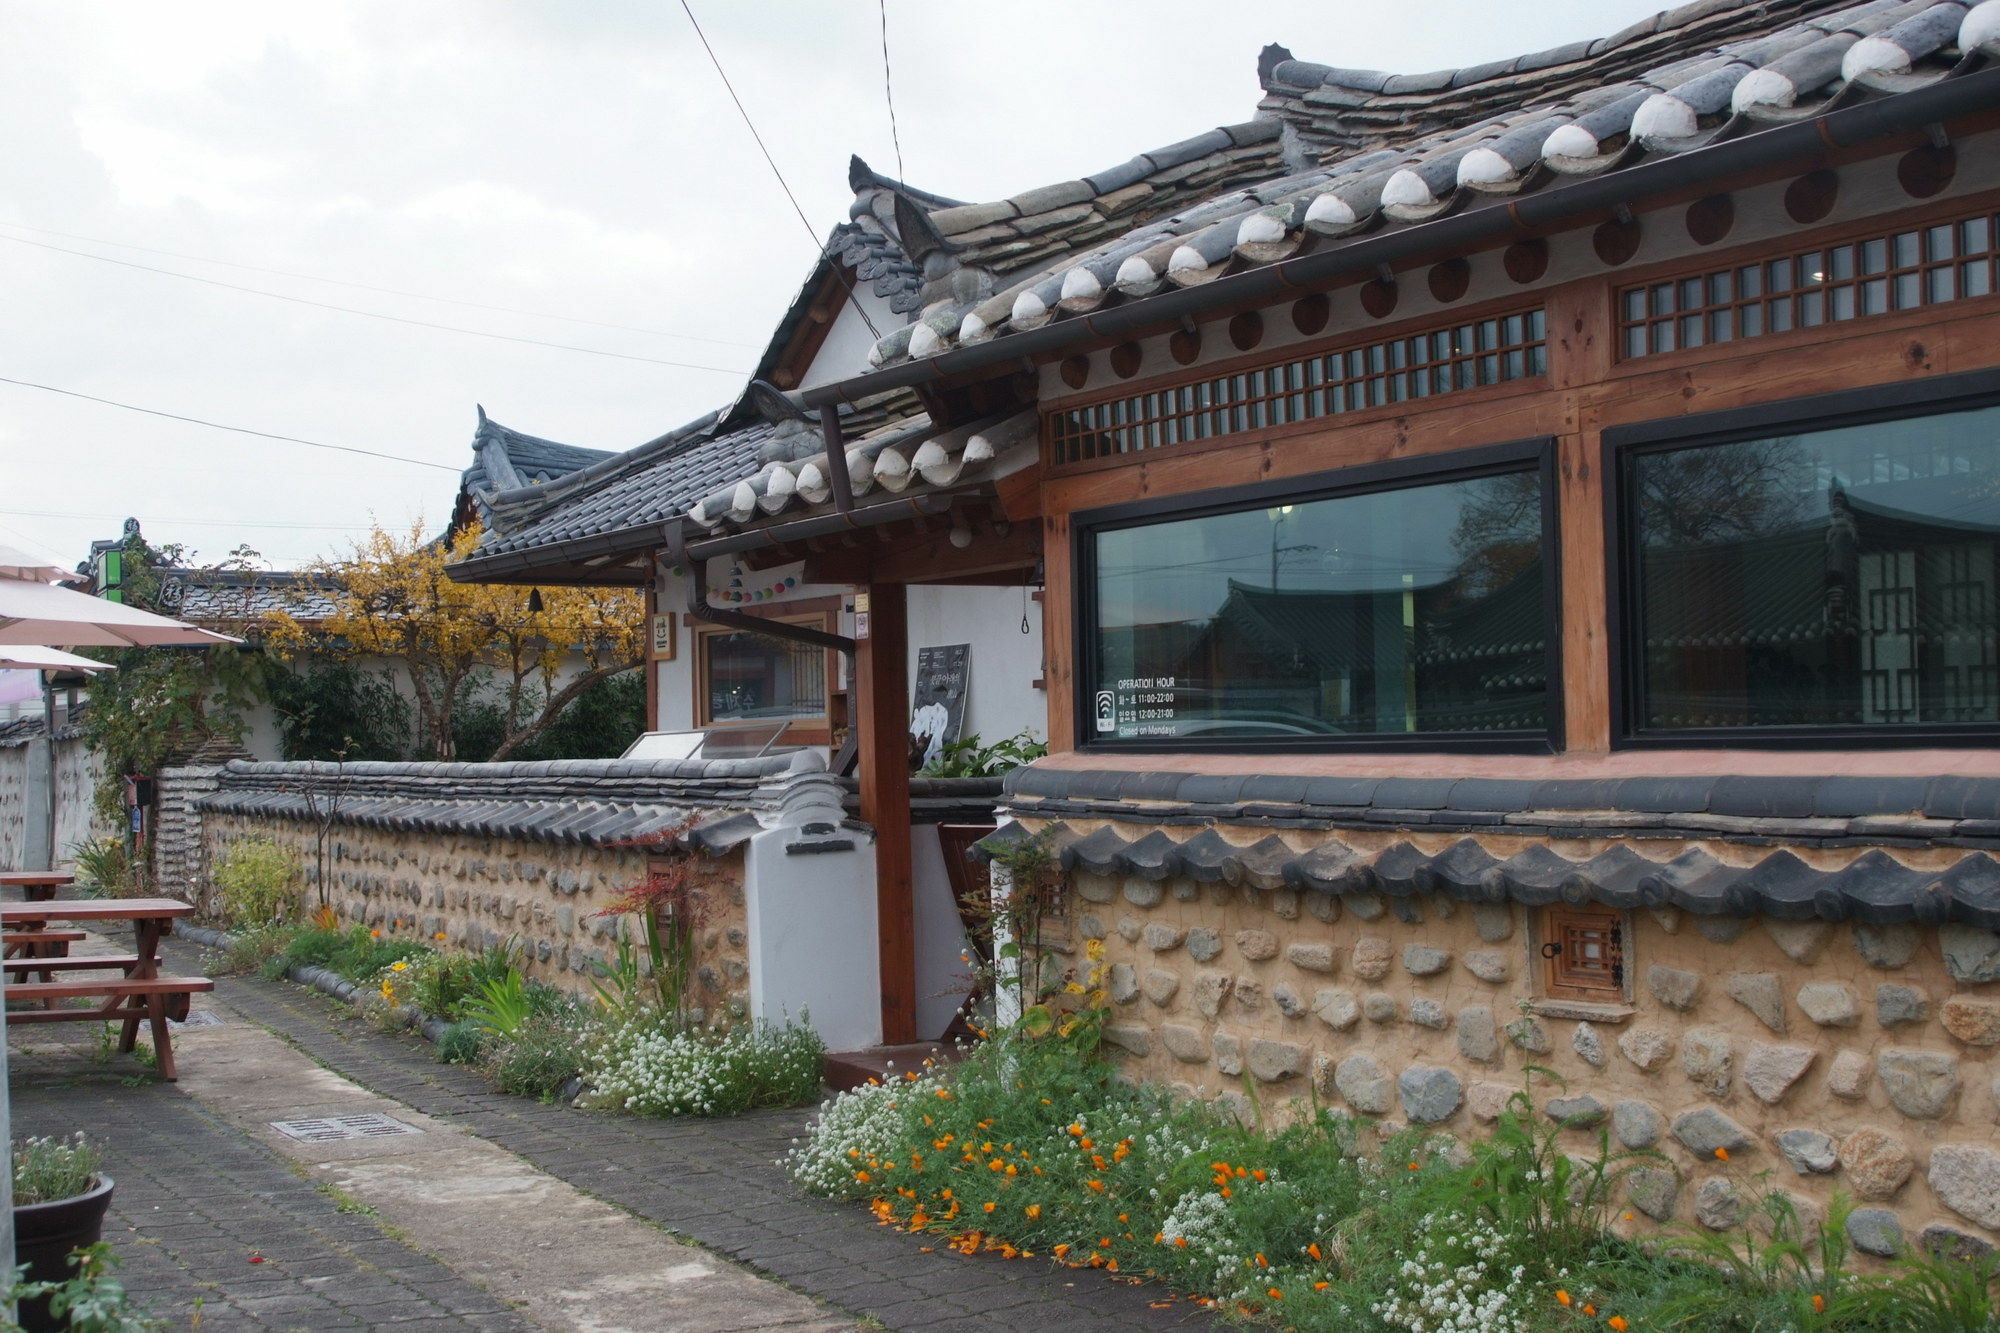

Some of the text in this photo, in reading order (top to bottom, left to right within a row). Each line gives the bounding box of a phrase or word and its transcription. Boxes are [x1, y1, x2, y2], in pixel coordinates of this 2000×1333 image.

[1118, 677, 1175, 689] OPERATION HOUR
[1138, 693, 1174, 703] 11:00-22:00
[1118, 709, 1174, 722] 일요일 12:00-21:00
[1119, 725, 1176, 736] Closed on Mondays
